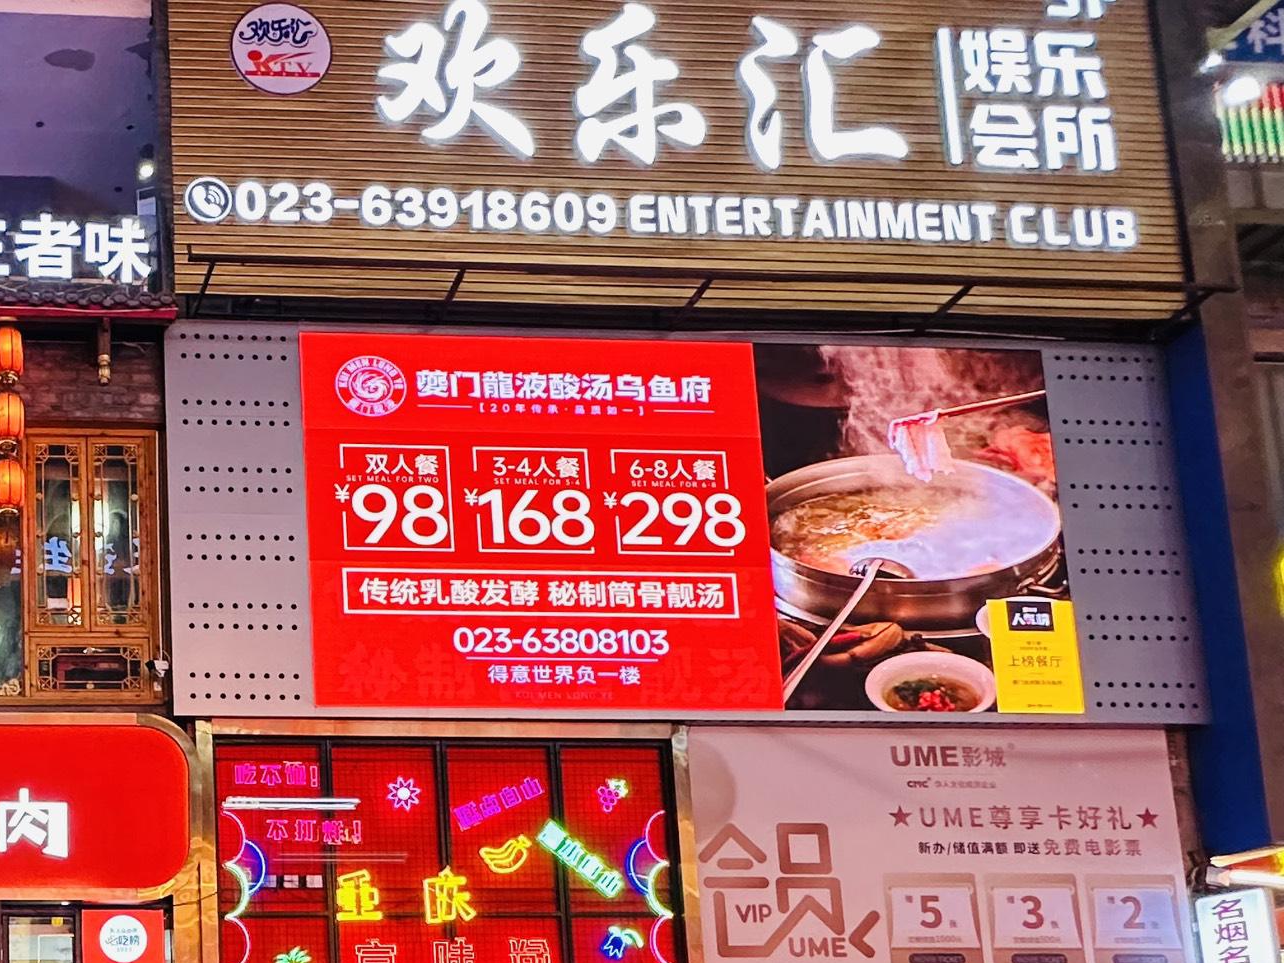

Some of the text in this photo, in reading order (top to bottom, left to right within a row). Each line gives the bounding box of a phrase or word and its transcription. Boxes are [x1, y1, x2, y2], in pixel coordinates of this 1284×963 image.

[959, 28, 1109, 100] 娱乐
[376, 0, 909, 172] 欢乐汇
[969, 104, 1118, 171] 会所
[234, 181, 1139, 250] 023-63918609 ENTERTAINMENT CLUB
[365, 454, 439, 476] 双人餐
[492, 456, 580, 478] 3-4人餐
[629, 459, 717, 481] 6-8人餐
[367, 475, 392, 483] MEAL
[543, 478, 561, 486] FOR
[651, 480, 676, 488] MEAL
[359, 577, 725, 610] 传统乳酸发酵 秘制筒骨靓汤
[453, 627, 669, 656] 023-63808103
[488, 665, 641, 686] 得意世界负一楼
[890, 745, 1007, 768] UME影城
[919, 804, 1132, 830] UME尊享卡好礼
[918, 840, 1008, 856] 新办/储值满额
[734, 903, 773, 924] VIP
[788, 937, 848, 959] UME
